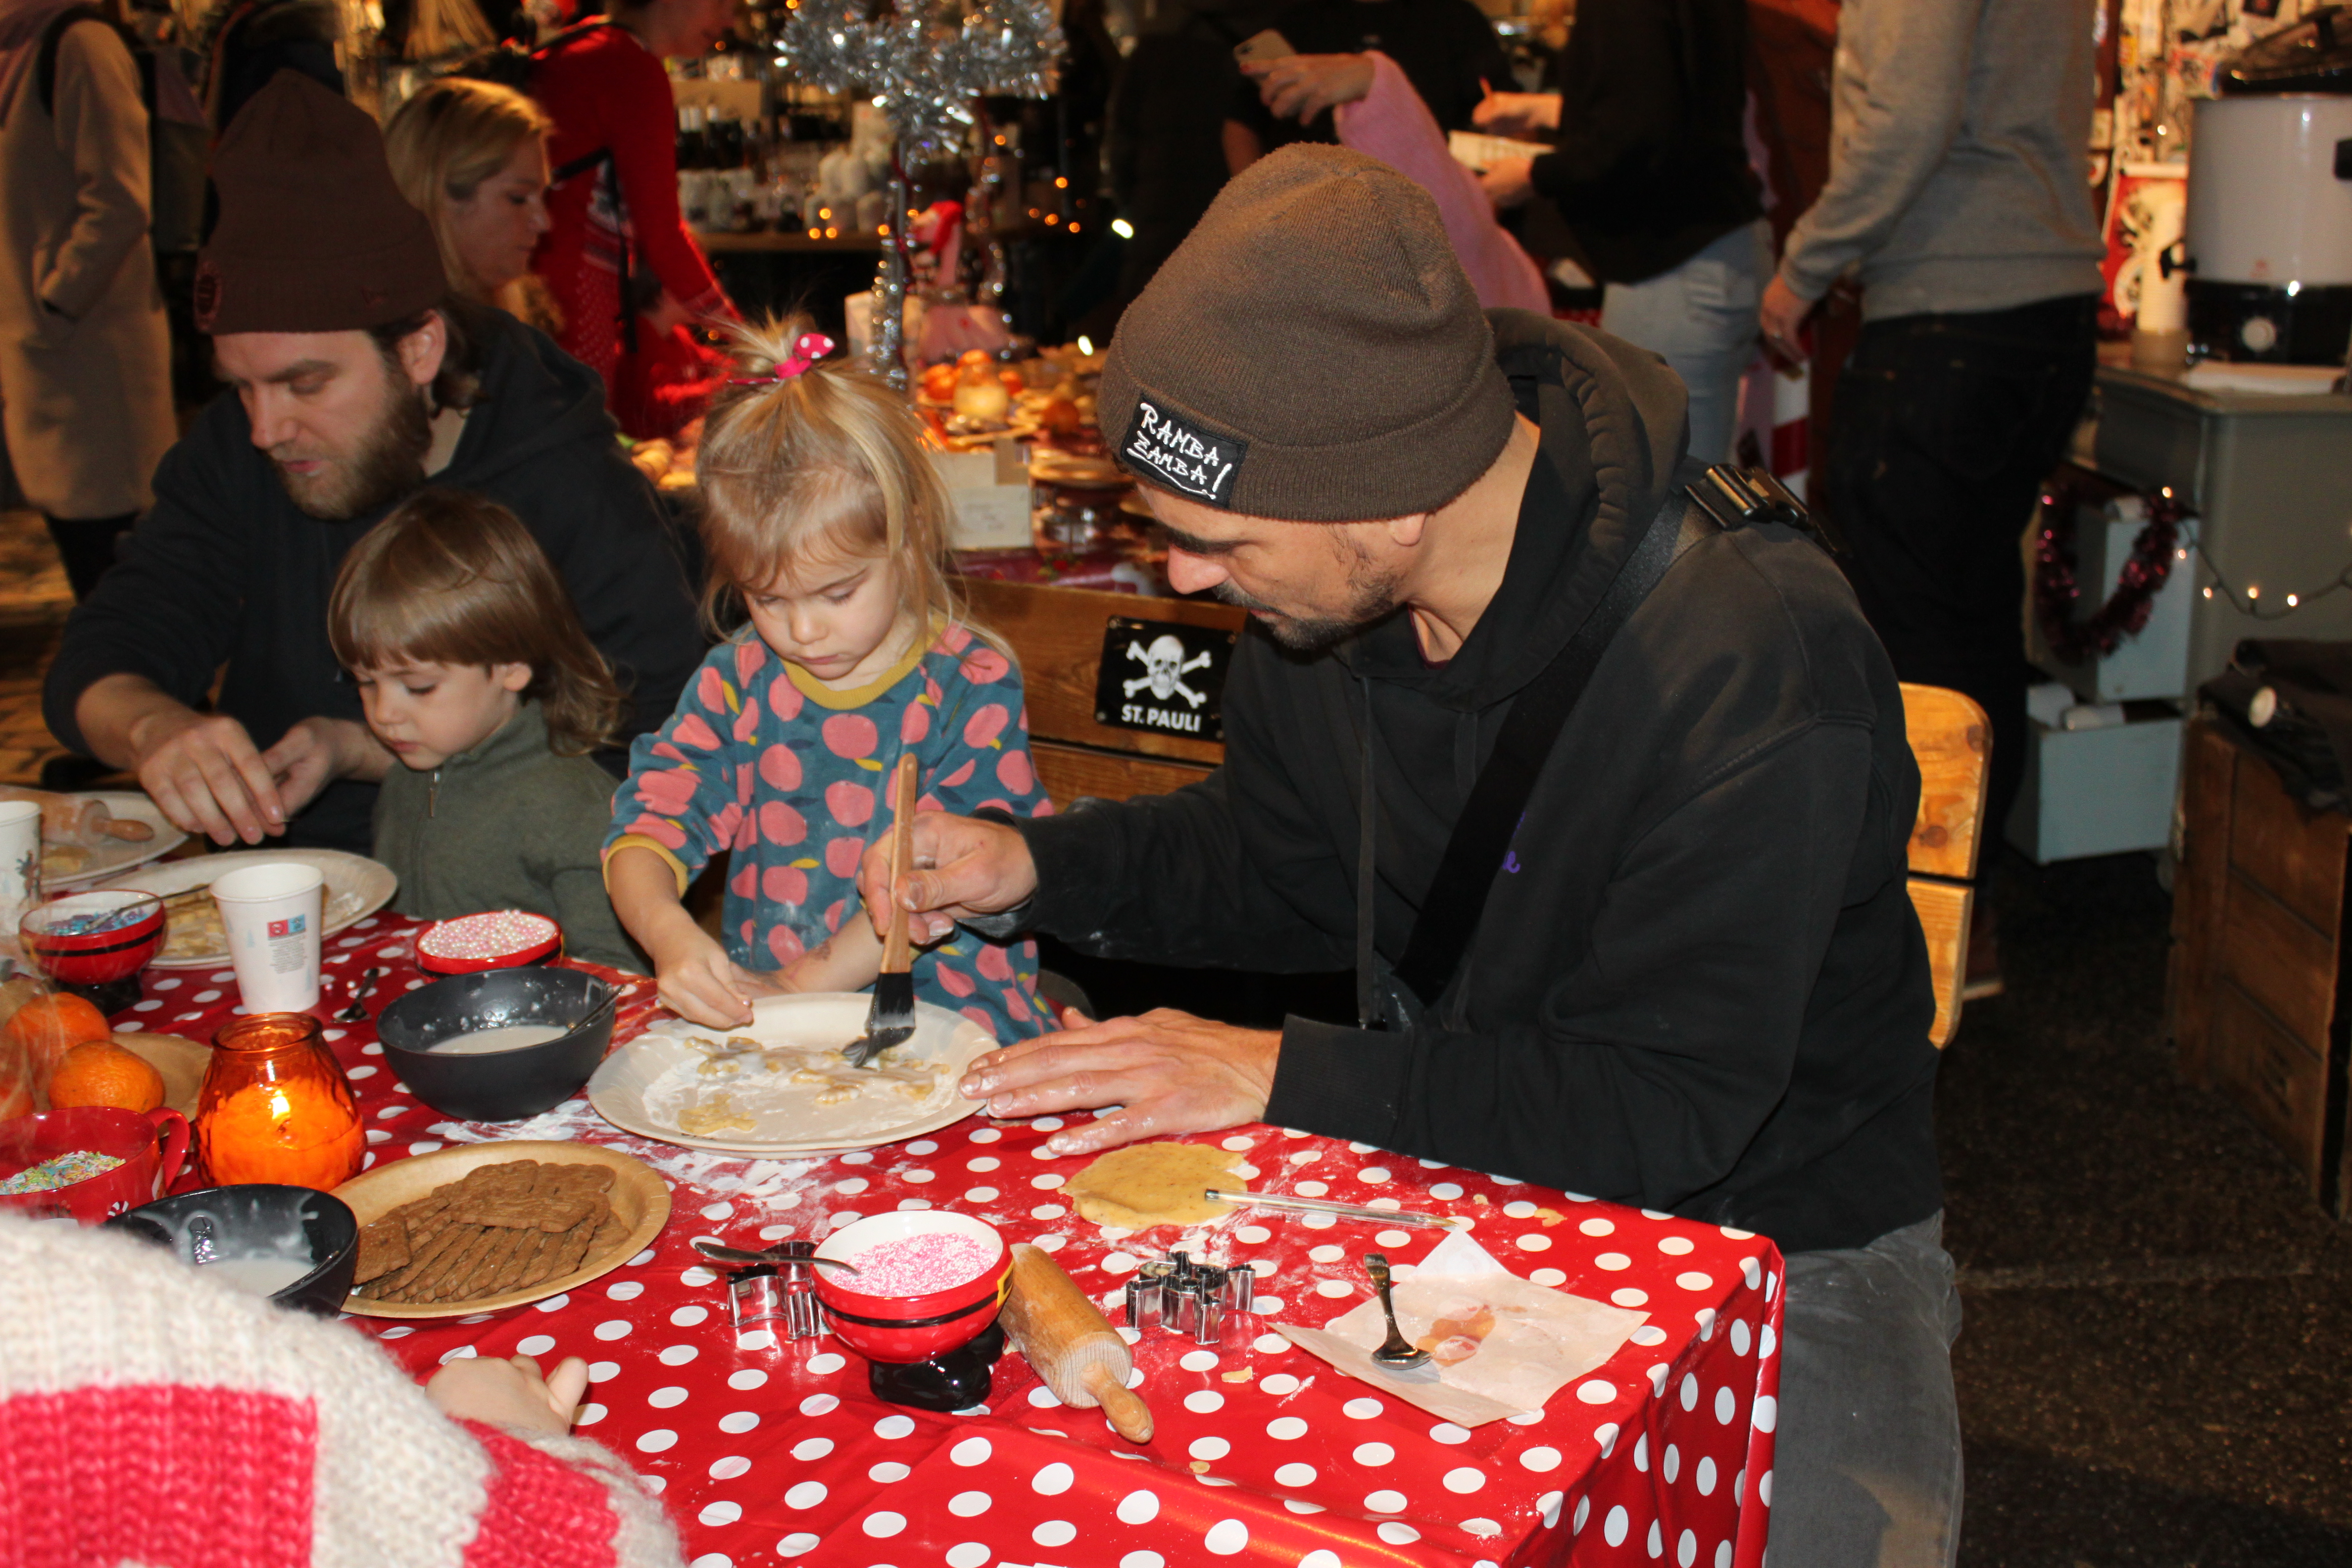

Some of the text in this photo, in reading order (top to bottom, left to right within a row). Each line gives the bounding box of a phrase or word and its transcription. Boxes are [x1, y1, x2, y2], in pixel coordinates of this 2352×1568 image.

[1140, 402, 1219, 466] RAMBA
[1121, 703, 1202, 732] ST. PAULI
